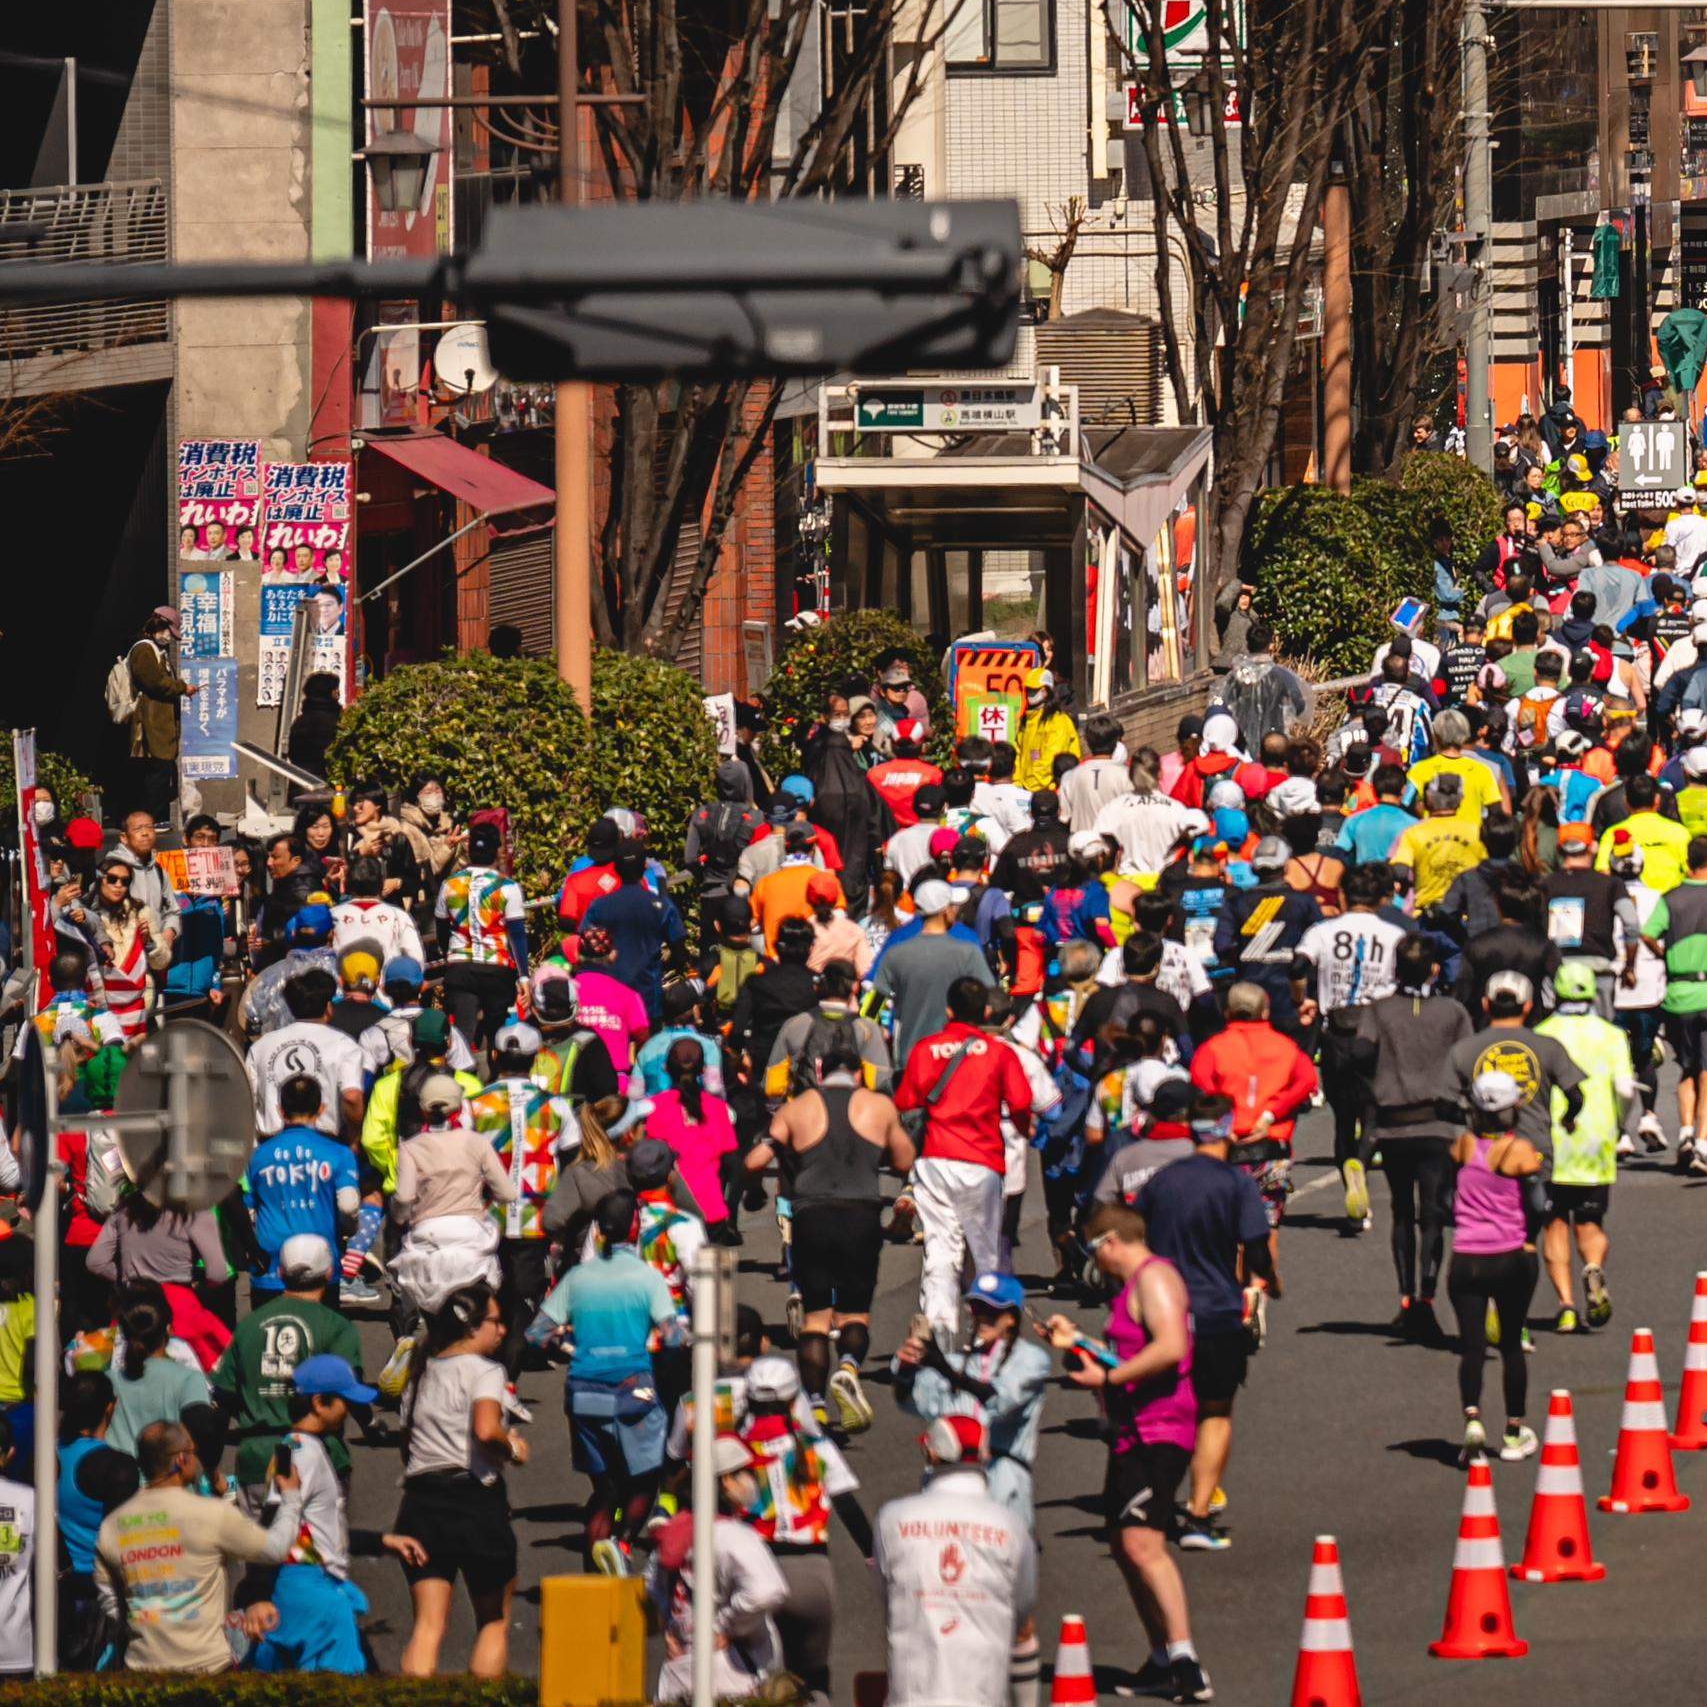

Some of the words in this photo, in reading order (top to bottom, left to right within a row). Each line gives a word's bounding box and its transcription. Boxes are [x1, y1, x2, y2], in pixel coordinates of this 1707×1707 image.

[179, 442, 257, 465] 消費税
[179, 466, 257, 481] インボイス
[267, 466, 346, 488] 消費税
[179, 482, 236, 498] は廃止
[267, 488, 346, 504] インボイス
[267, 505, 323, 520] は廃止
[196, 592, 218, 633] 幸福
[259, 1160, 332, 1193] TOKYO
[898, 1520, 1010, 1546] VOLUNTEER
[119, 1545, 182, 1567] LONDON
